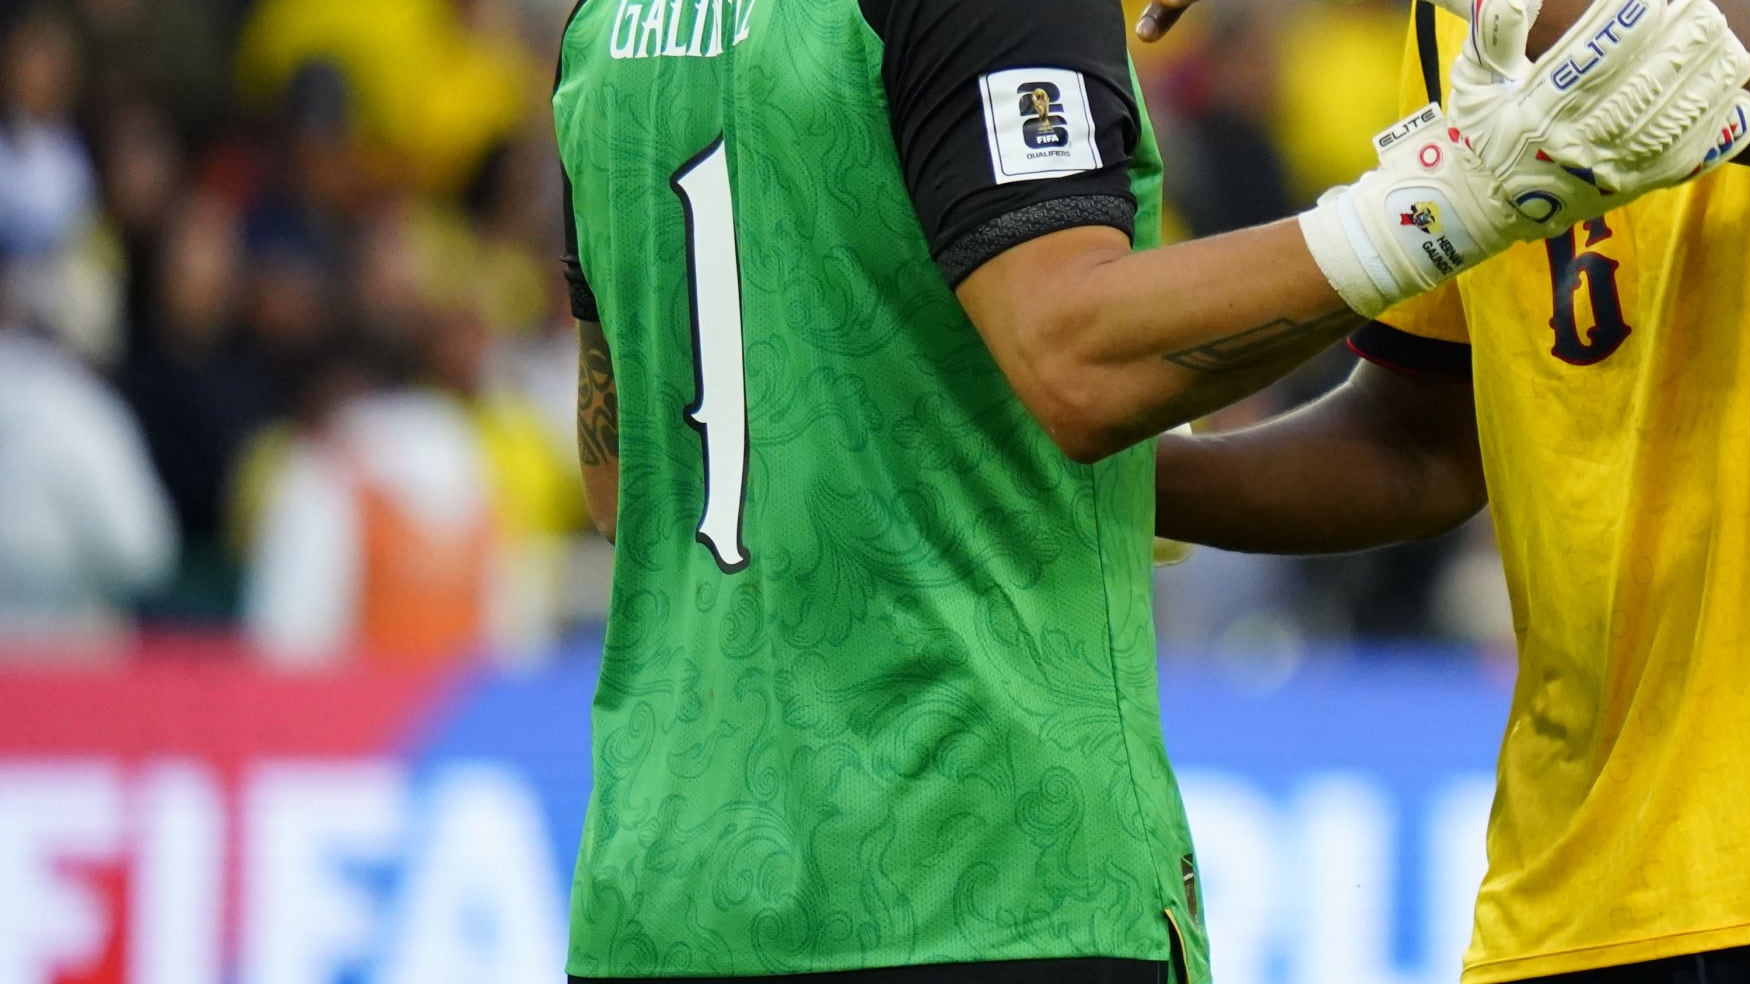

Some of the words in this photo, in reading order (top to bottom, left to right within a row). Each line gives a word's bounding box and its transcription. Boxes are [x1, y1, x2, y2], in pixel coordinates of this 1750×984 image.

[1036, 134, 1060, 145] FIFA
[1379, 108, 1436, 147] ELITE
[1026, 150, 1071, 160] QUALIFIERS
[671, 131, 750, 574] 1
[0, 751, 570, 984] FIFA
